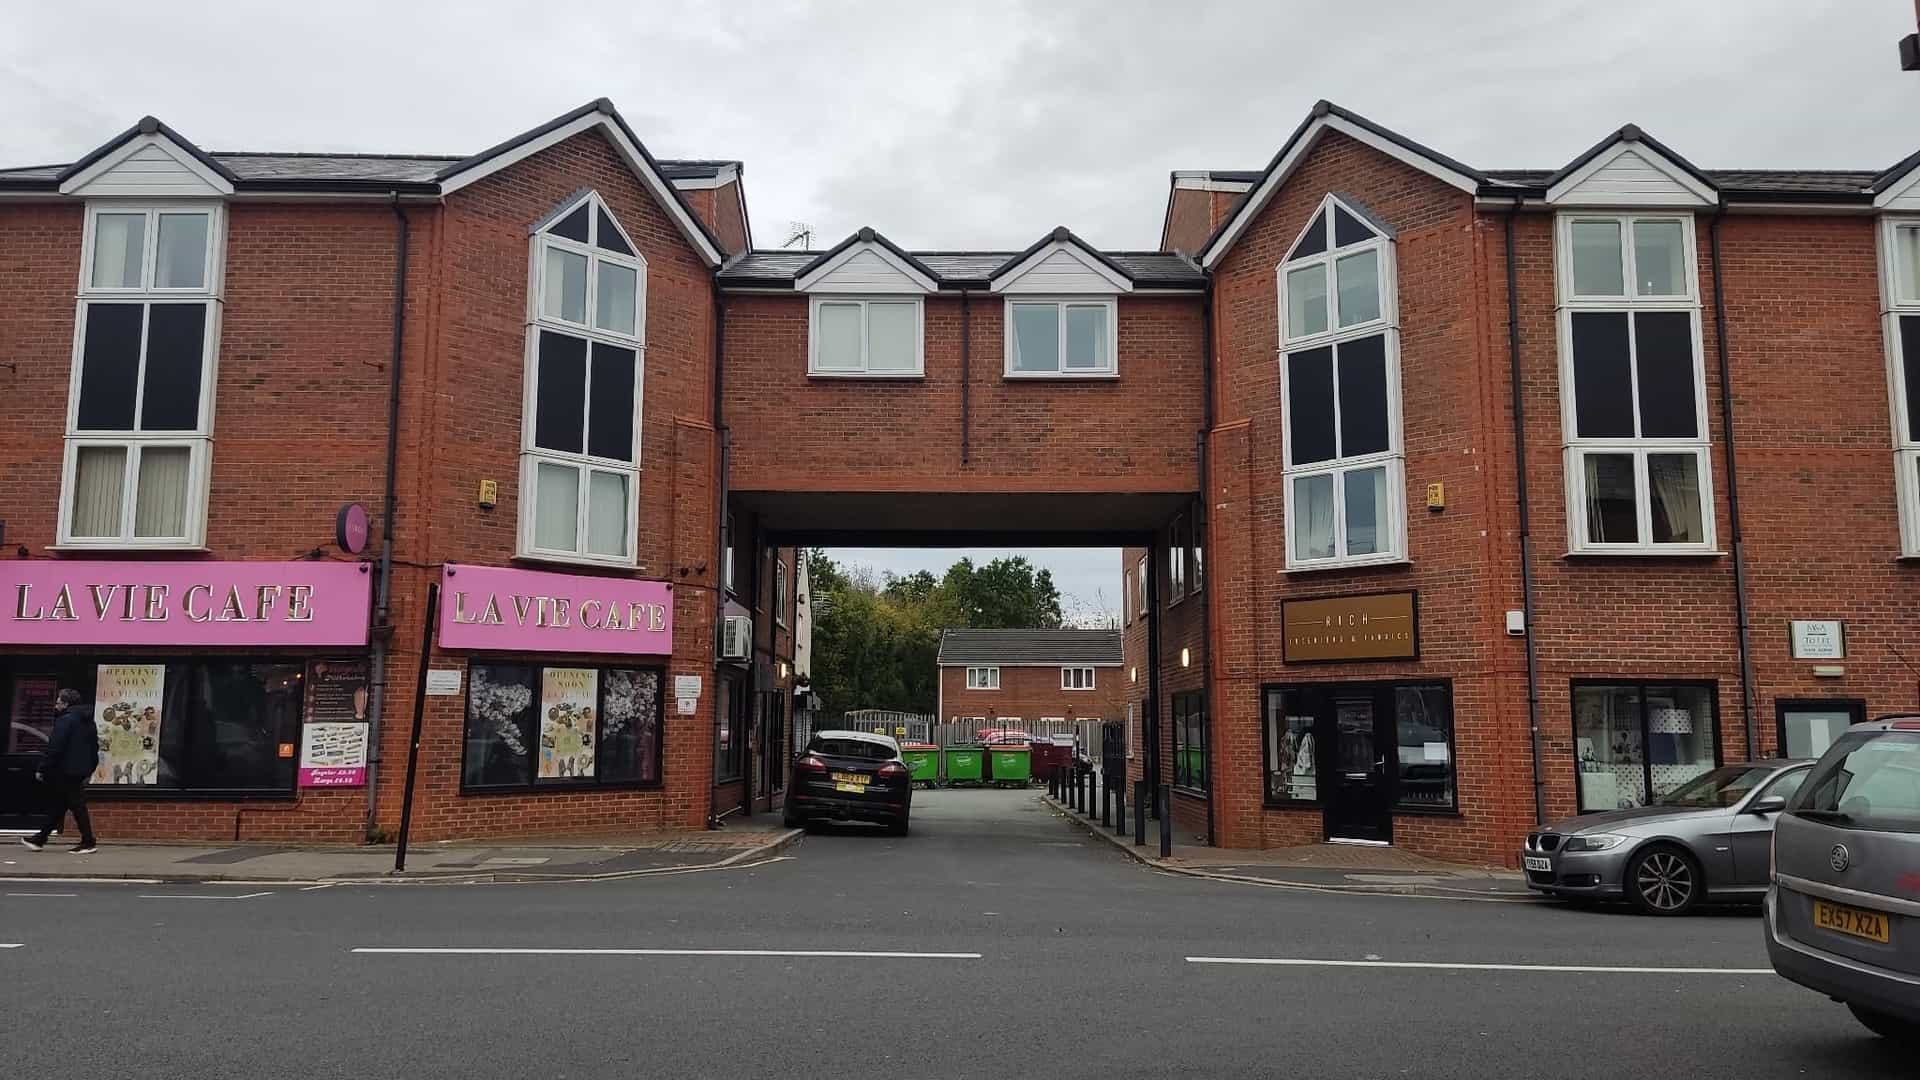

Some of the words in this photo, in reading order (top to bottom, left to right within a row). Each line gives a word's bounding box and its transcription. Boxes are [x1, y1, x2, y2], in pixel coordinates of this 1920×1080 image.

[11, 584, 80, 621] LA
[85, 584, 169, 622] VIE
[182, 584, 314, 622] CAFE
[453, 591, 505, 625] LA
[509, 594, 572, 628] VIE
[579, 599, 666, 632] CAFE
[1326, 613, 1368, 627] RICH
[1364, 632, 1409, 641] FABRICS
[550, 671, 593, 680] OPENING
[1820, 904, 1851, 929] EX57
[1856, 912, 1882, 938] XZA
